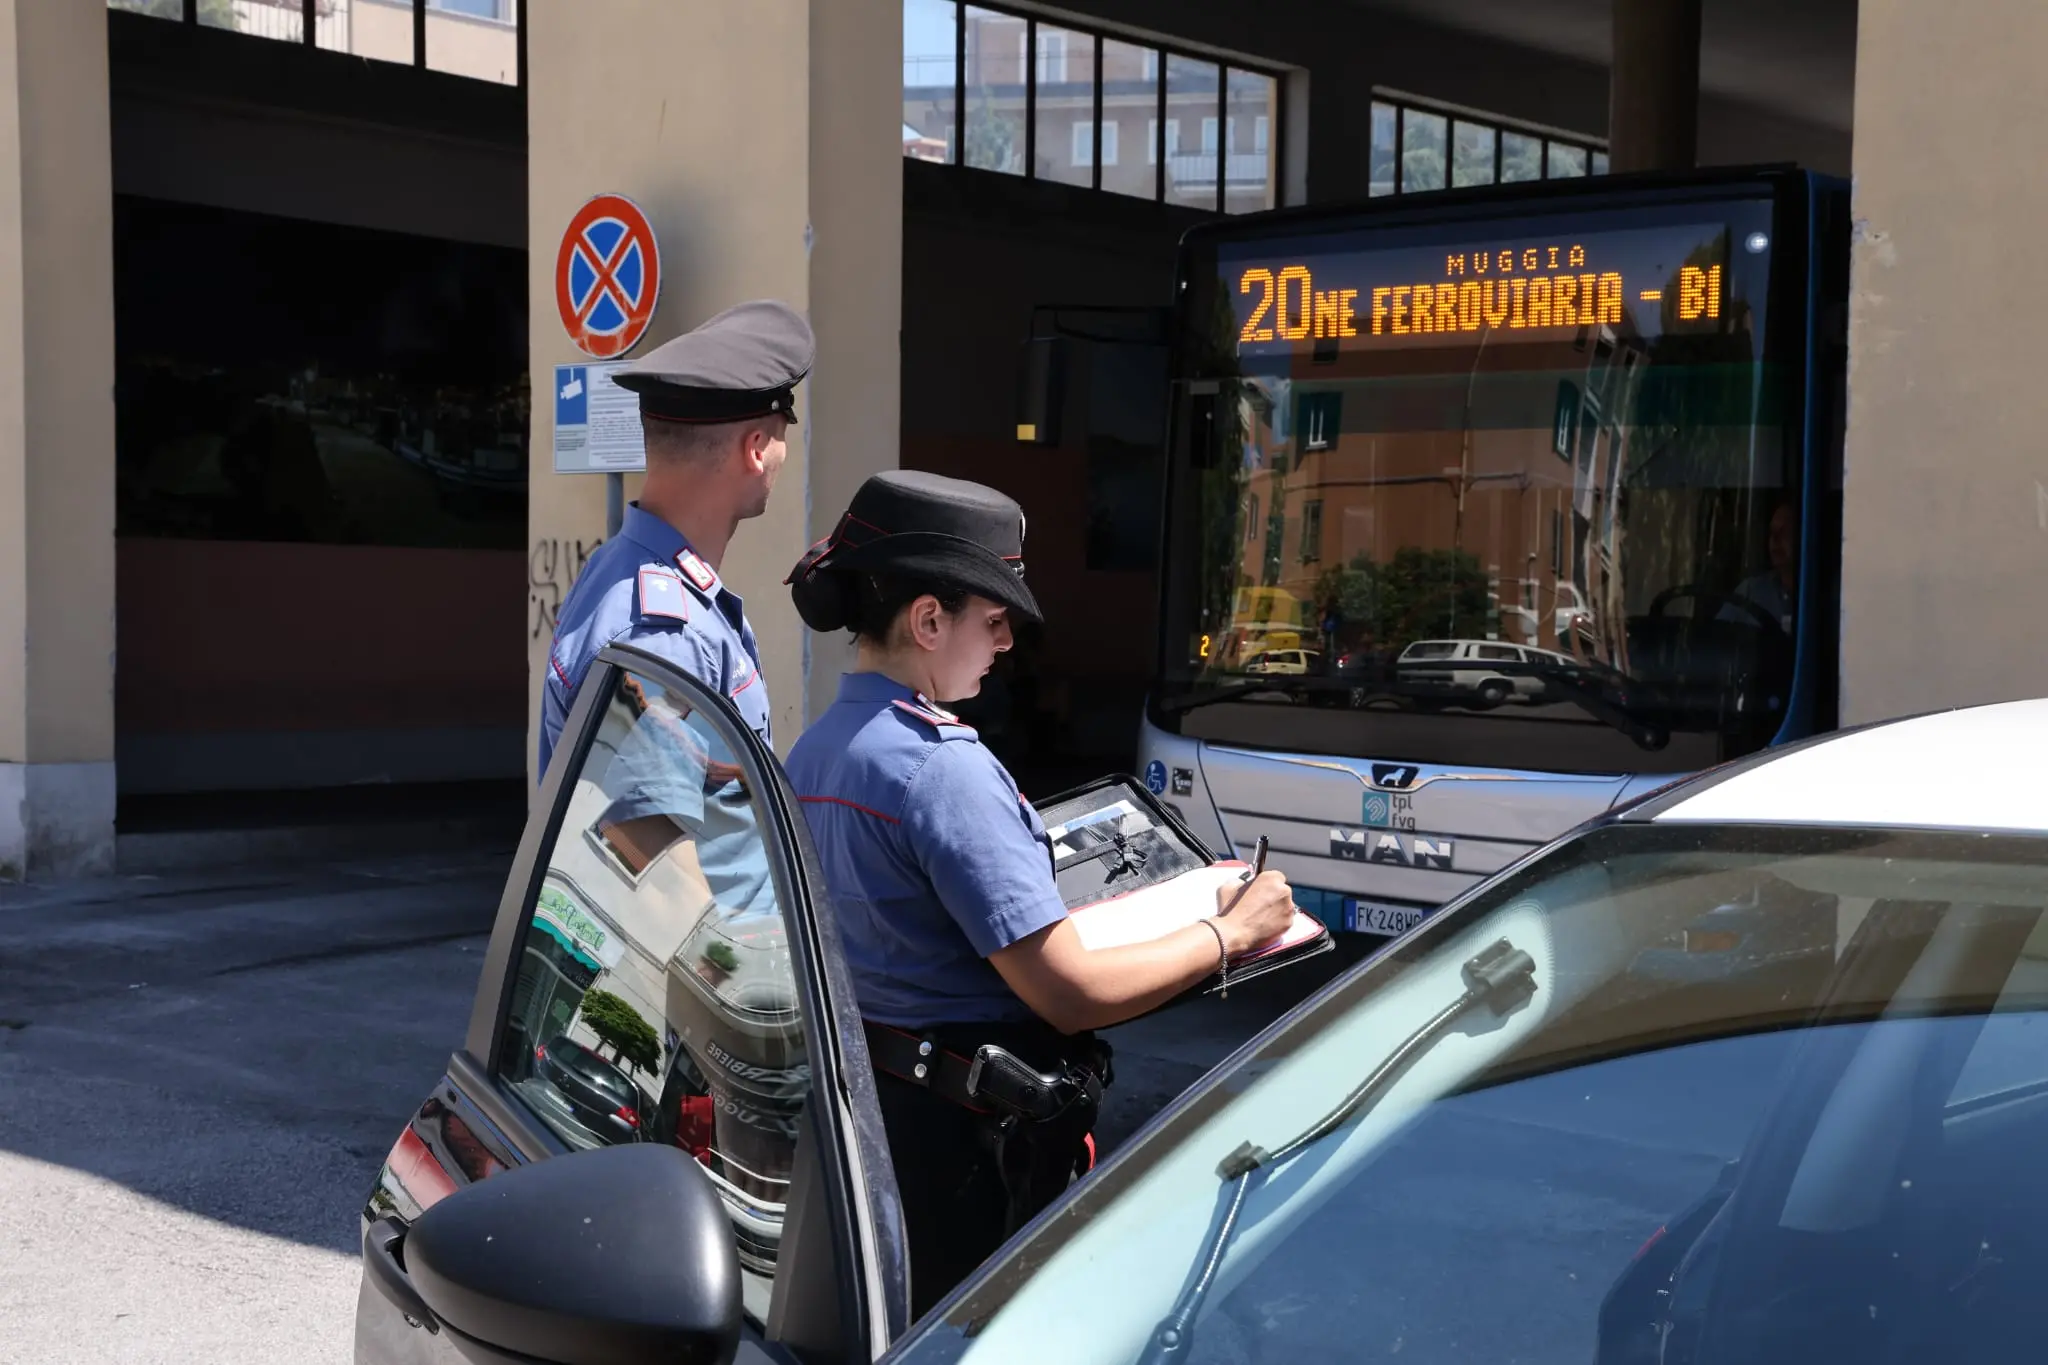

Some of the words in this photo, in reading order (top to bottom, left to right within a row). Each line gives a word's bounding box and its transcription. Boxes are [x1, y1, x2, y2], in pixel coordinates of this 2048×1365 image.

[1447, 244, 1585, 276] MUGGIA
[1240, 265, 1311, 342] 20
[1314, 289, 1357, 338] NE
[1372, 271, 1622, 335] FERROVIARIA
[1392, 794, 1413, 812] tpl
[1392, 813, 1416, 832] fvg
[1330, 828, 1454, 868] MAN
